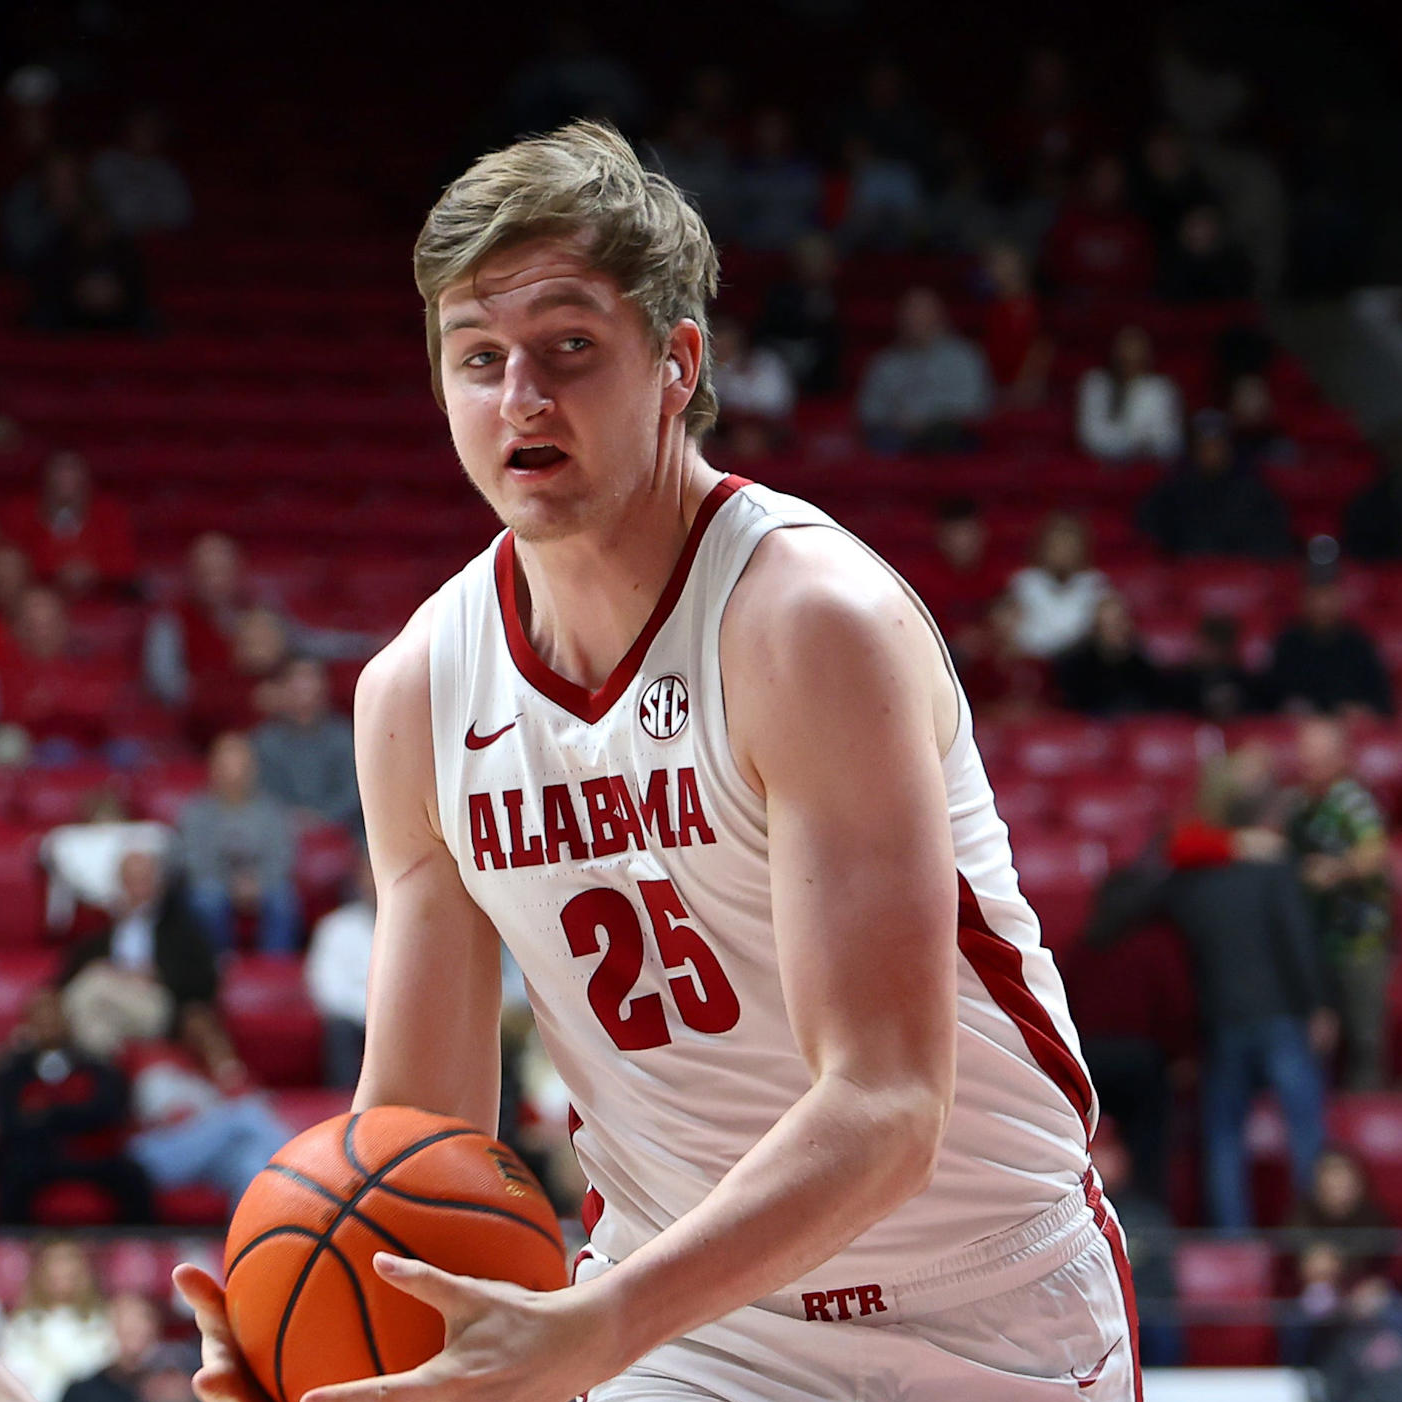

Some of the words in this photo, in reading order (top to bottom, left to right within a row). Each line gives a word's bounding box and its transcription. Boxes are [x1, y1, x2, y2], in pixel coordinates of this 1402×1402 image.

[640, 677, 688, 738] SEC
[468, 766, 717, 871] ALABAMA
[559, 879, 741, 1051] 25
[801, 1283, 888, 1322] RTR
